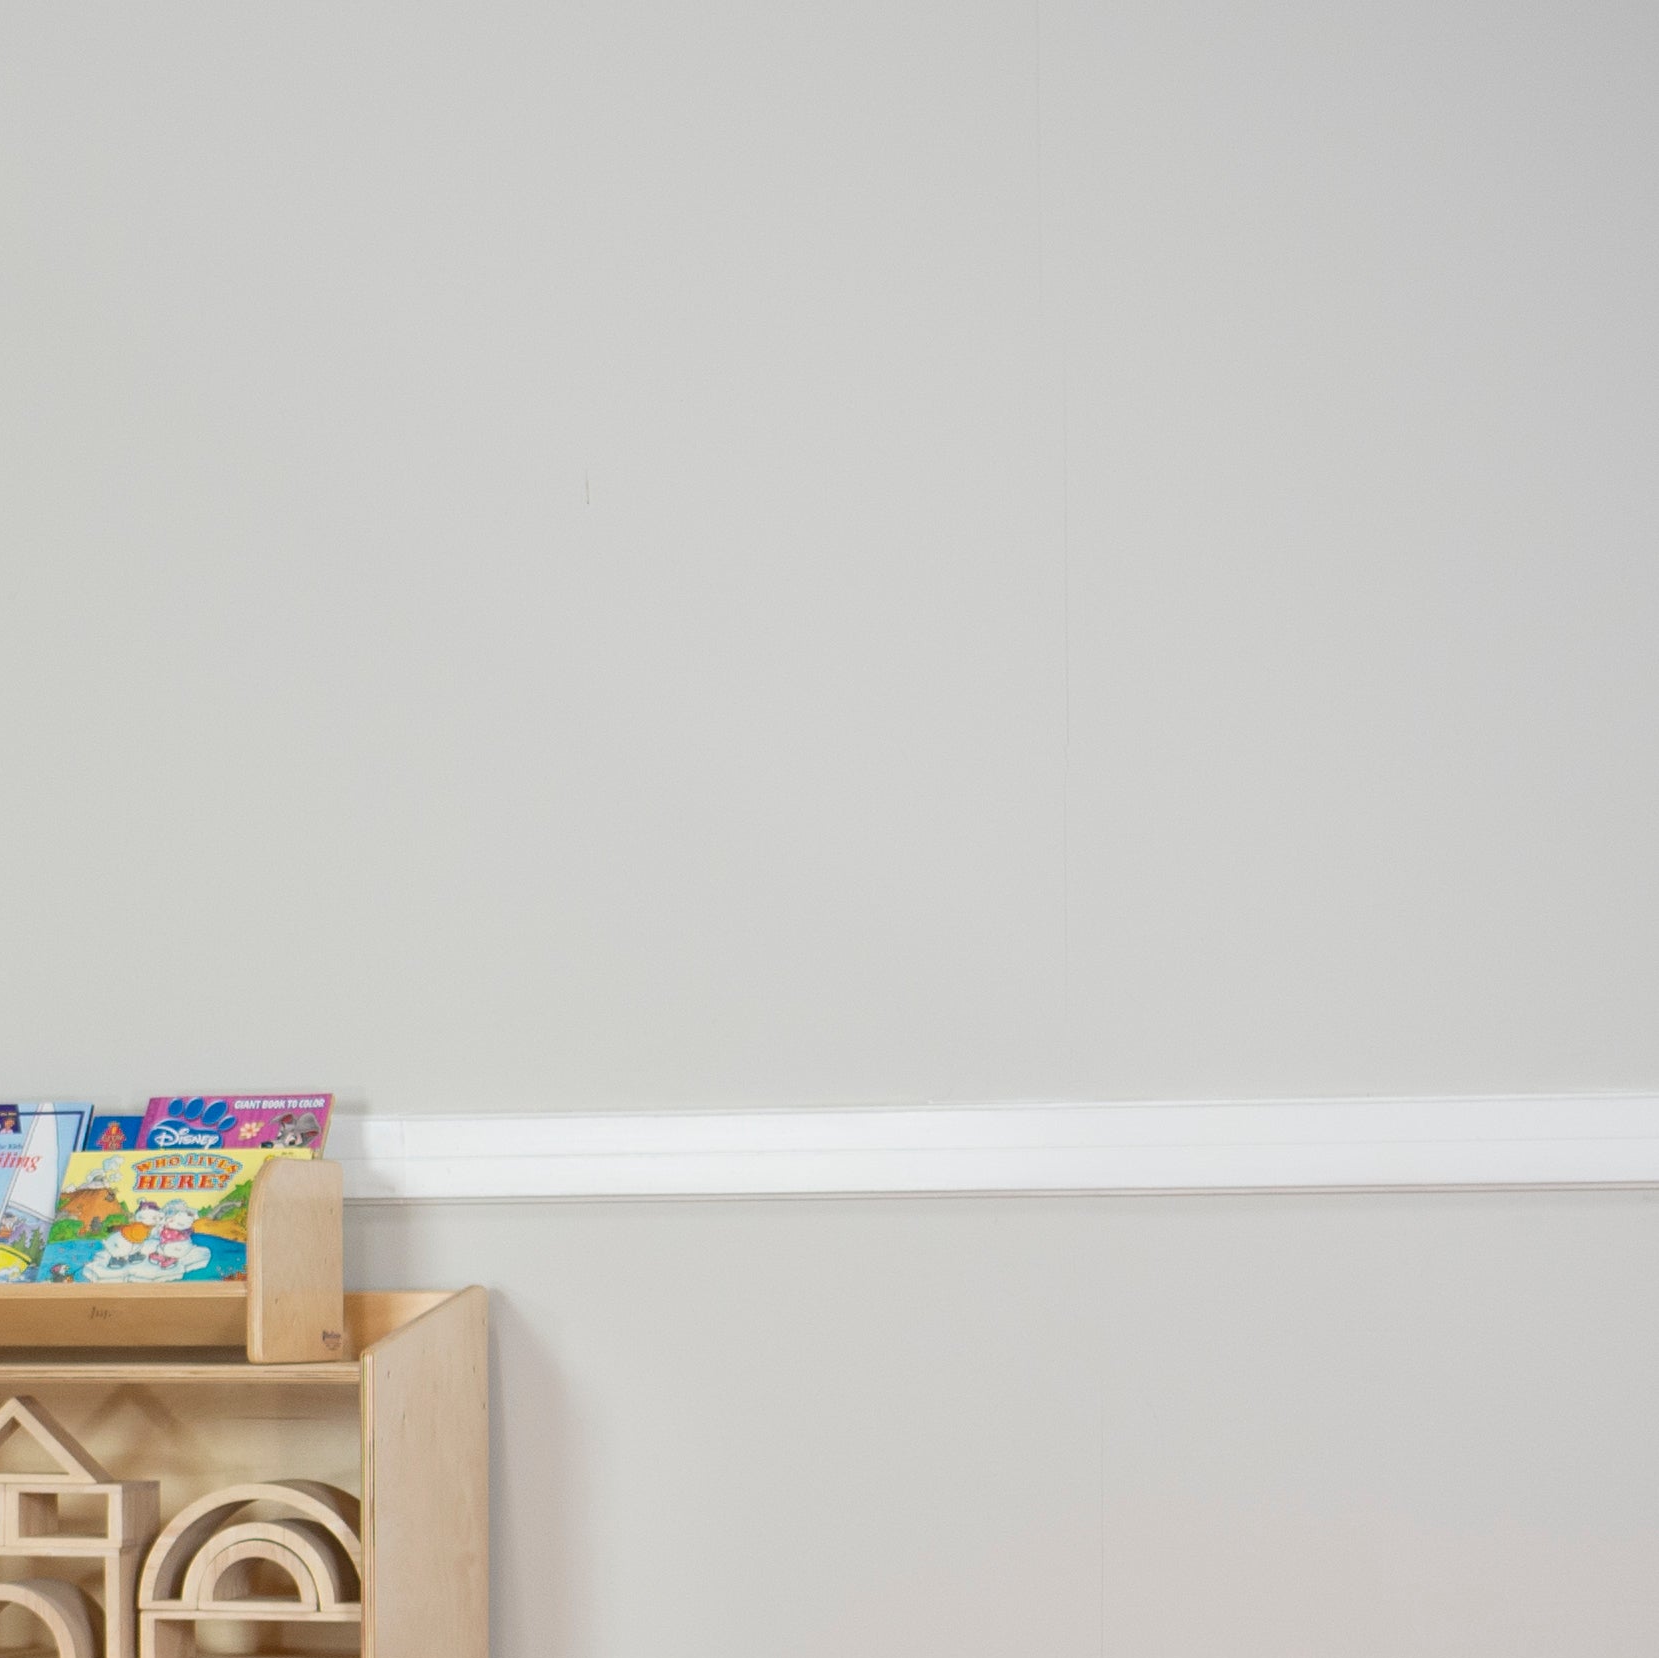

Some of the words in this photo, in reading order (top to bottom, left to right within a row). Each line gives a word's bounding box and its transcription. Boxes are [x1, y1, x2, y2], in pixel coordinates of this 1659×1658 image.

[234, 1100, 261, 1110] GIANT
[262, 1100, 286, 1109] BOOK
[287, 1099, 299, 1109] TO
[299, 1098, 325, 1108] COLOR
[135, 1155, 182, 1173] WHO
[185, 1154, 241, 1173] LIVES
[135, 1173, 231, 1191] HERE?
